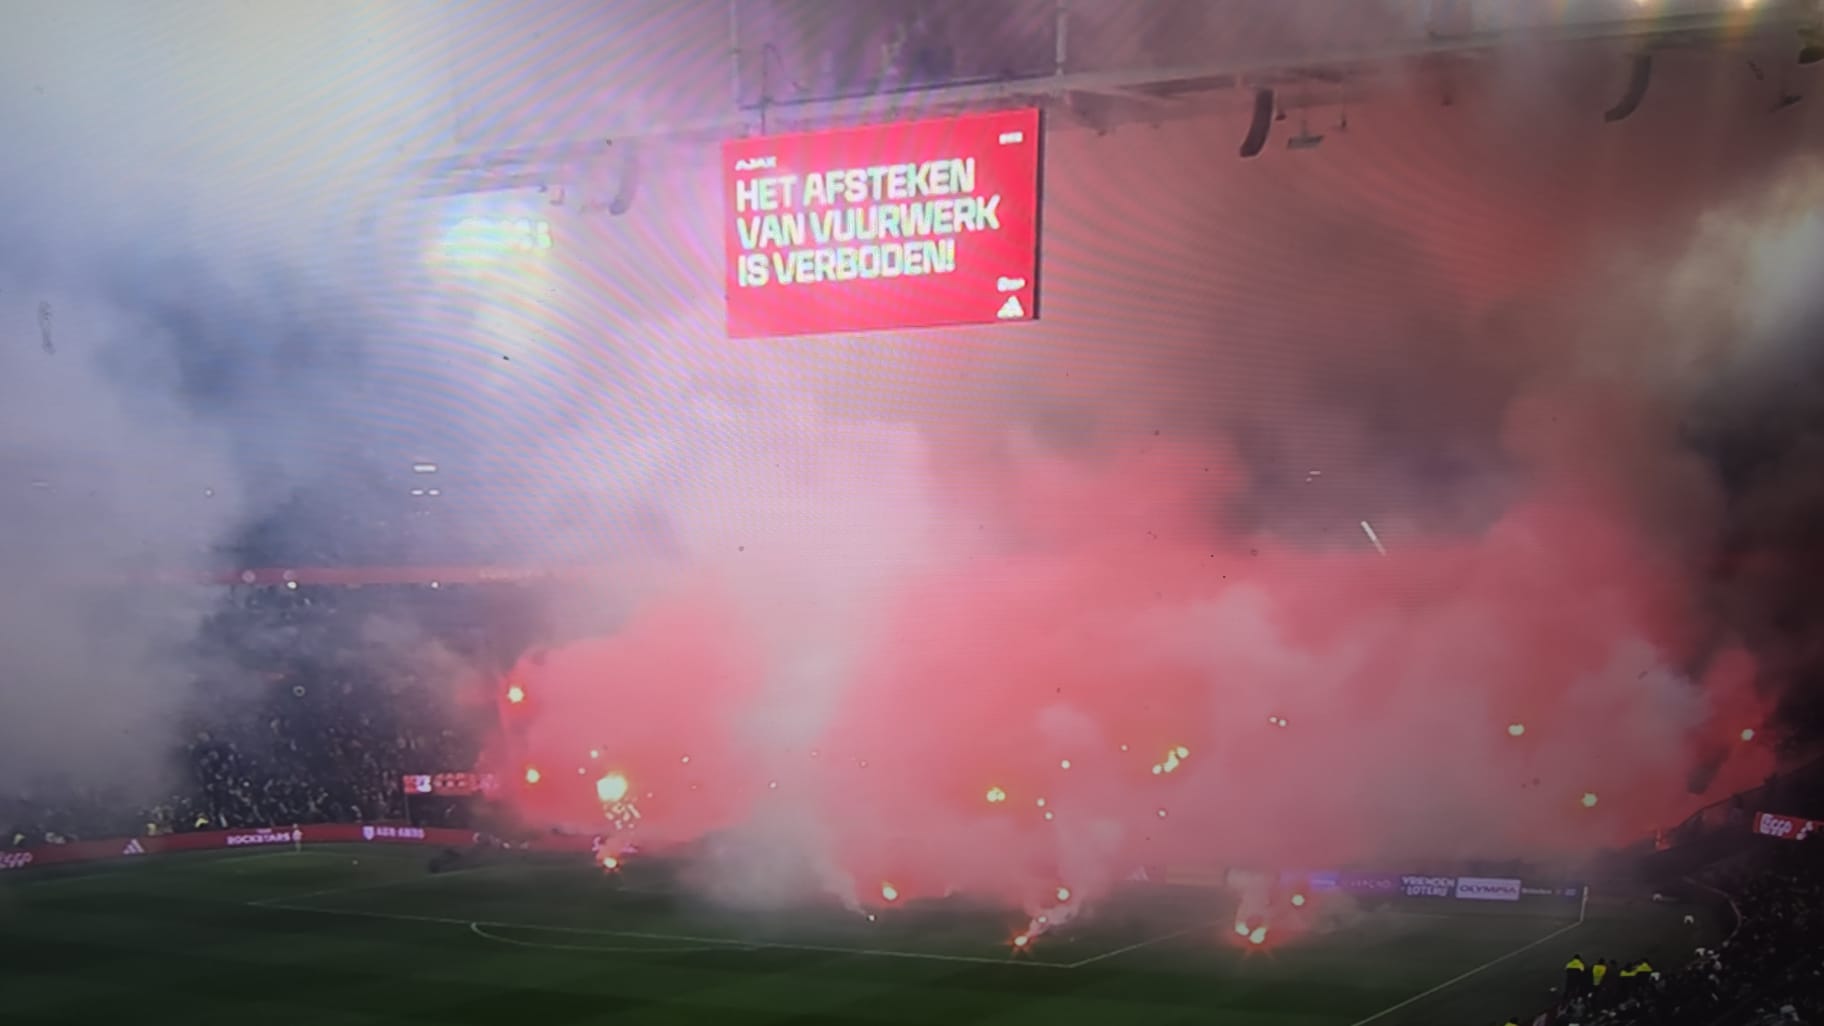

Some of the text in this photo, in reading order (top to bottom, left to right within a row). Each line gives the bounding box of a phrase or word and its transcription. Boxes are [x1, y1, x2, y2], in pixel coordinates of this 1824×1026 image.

[736, 157, 975, 212] HET AFSTEKEN
[736, 194, 1001, 250] VAN VUURWERK
[738, 239, 955, 287] IS VERBODEN!
[1459, 884, 1517, 894] OLYMPIA
